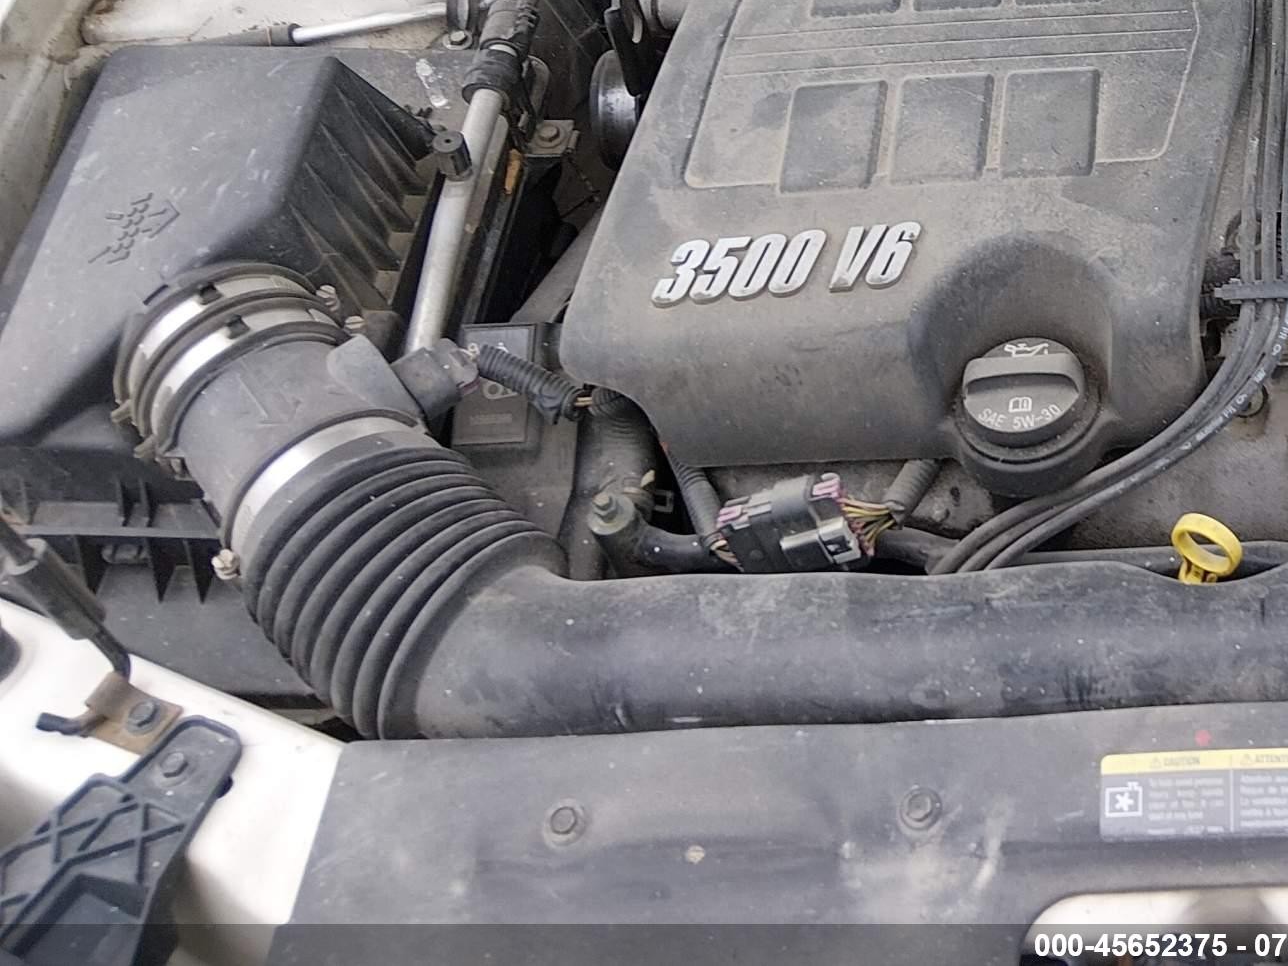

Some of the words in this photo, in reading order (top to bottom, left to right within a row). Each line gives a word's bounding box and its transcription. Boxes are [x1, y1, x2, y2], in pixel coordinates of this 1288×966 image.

[652, 229, 826, 307] 3500
[829, 221, 921, 293] V6
[978, 408, 1007, 428] SAE
[1012, 403, 1062, 430] 5W-30
